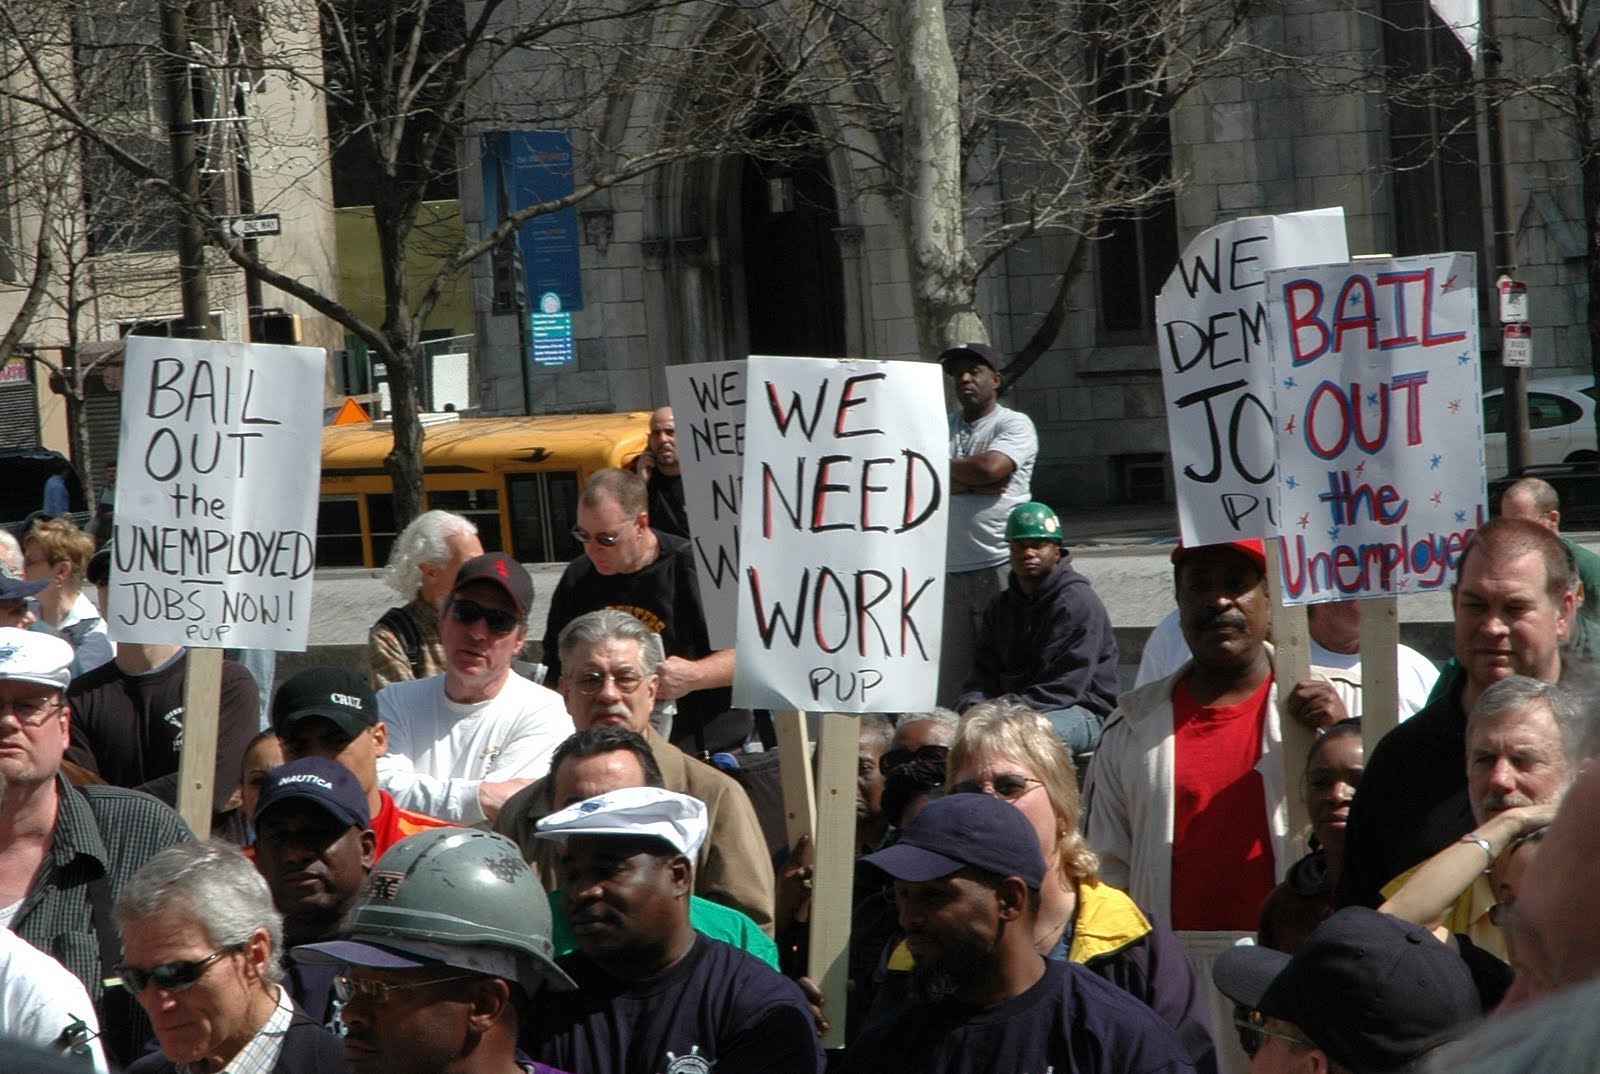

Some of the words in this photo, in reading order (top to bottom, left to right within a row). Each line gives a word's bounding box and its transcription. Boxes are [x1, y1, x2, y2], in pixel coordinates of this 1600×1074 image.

[1179, 236, 1268, 298] WE
[1162, 301, 1266, 373] DEM
[1283, 267, 1467, 368] BAIL
[147, 357, 282, 425] BAIL
[689, 371, 746, 413] WE
[764, 372, 886, 442] WE
[1304, 370, 1429, 461] OUT
[145, 427, 264, 482] OUT
[690, 418, 746, 462] NEE
[1174, 379, 1275, 485] JO
[169, 484, 225, 520] the
[761, 448, 942, 540] NEED
[1319, 470, 1408, 527] the
[113, 524, 314, 581] UNEMPLOYED
[119, 582, 206, 626] JOBS
[222, 590, 294, 632] NOW!
[185, 625, 231, 641] PUP
[747, 565, 936, 662] WORK
[330, 693, 363, 710] CRUZ
[809, 667, 883, 703] PUP
[278, 774, 333, 791] NAUTICA
